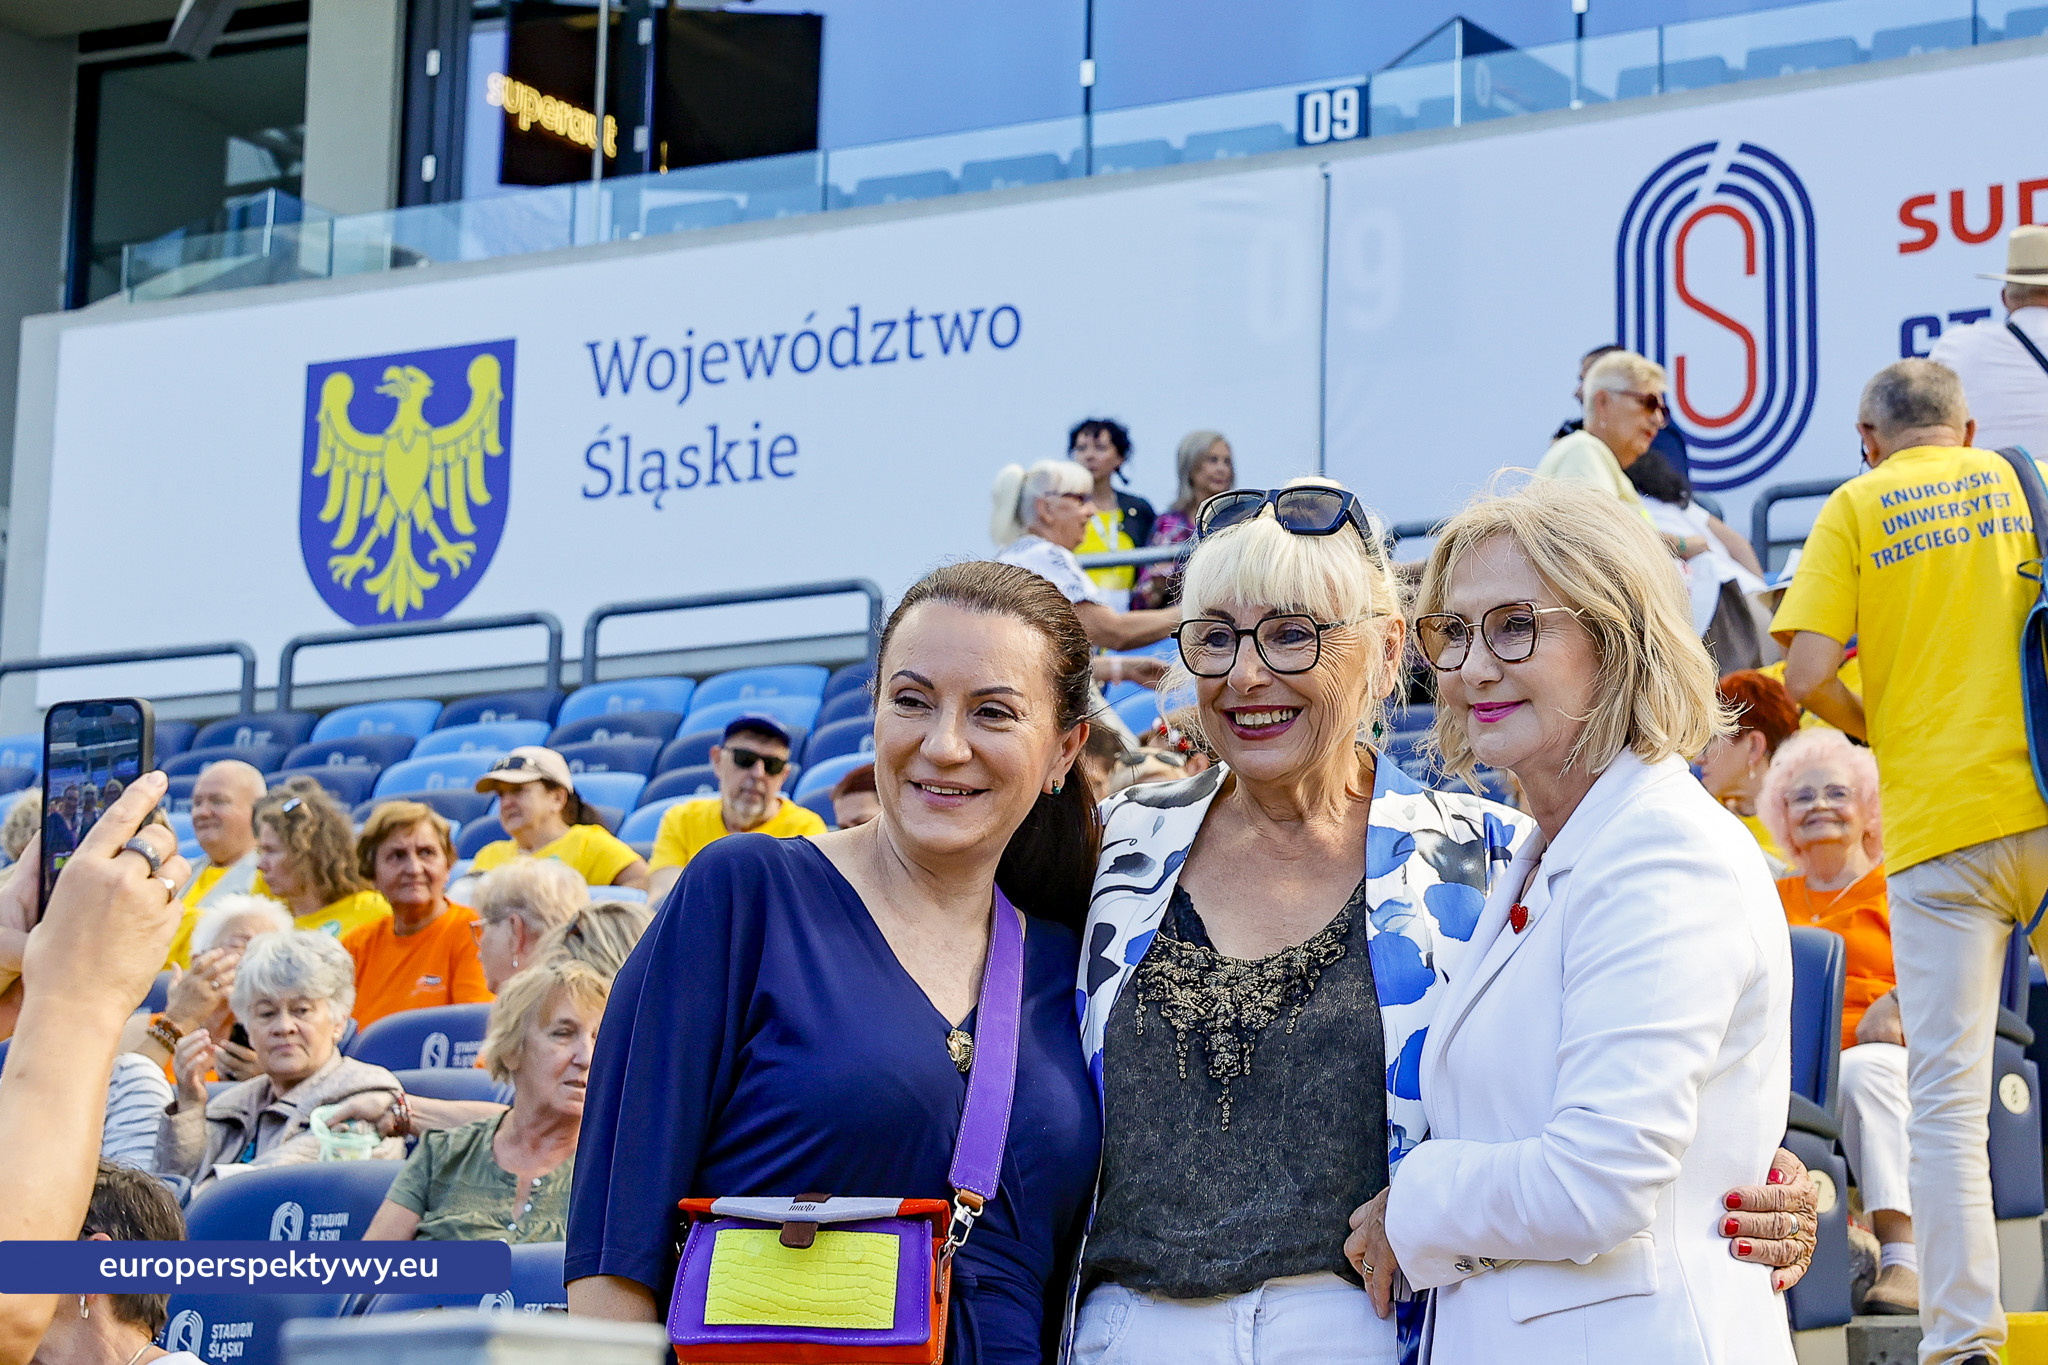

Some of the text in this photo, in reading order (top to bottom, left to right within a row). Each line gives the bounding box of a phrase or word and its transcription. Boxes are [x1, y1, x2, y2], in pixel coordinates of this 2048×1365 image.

[1303, 87, 1360, 145] 09
[584, 304, 1021, 406] Województwo
[581, 421, 799, 510] Śląskie
[1880, 471, 2001, 509] KNUROWSKI
[1882, 492, 2011, 536] UNIWERSYTET
[1870, 526, 1971, 569] TRZECIEGO
[208, 1340, 244, 1362] ŚLĄSKI
[211, 1321, 254, 1339] STADION
